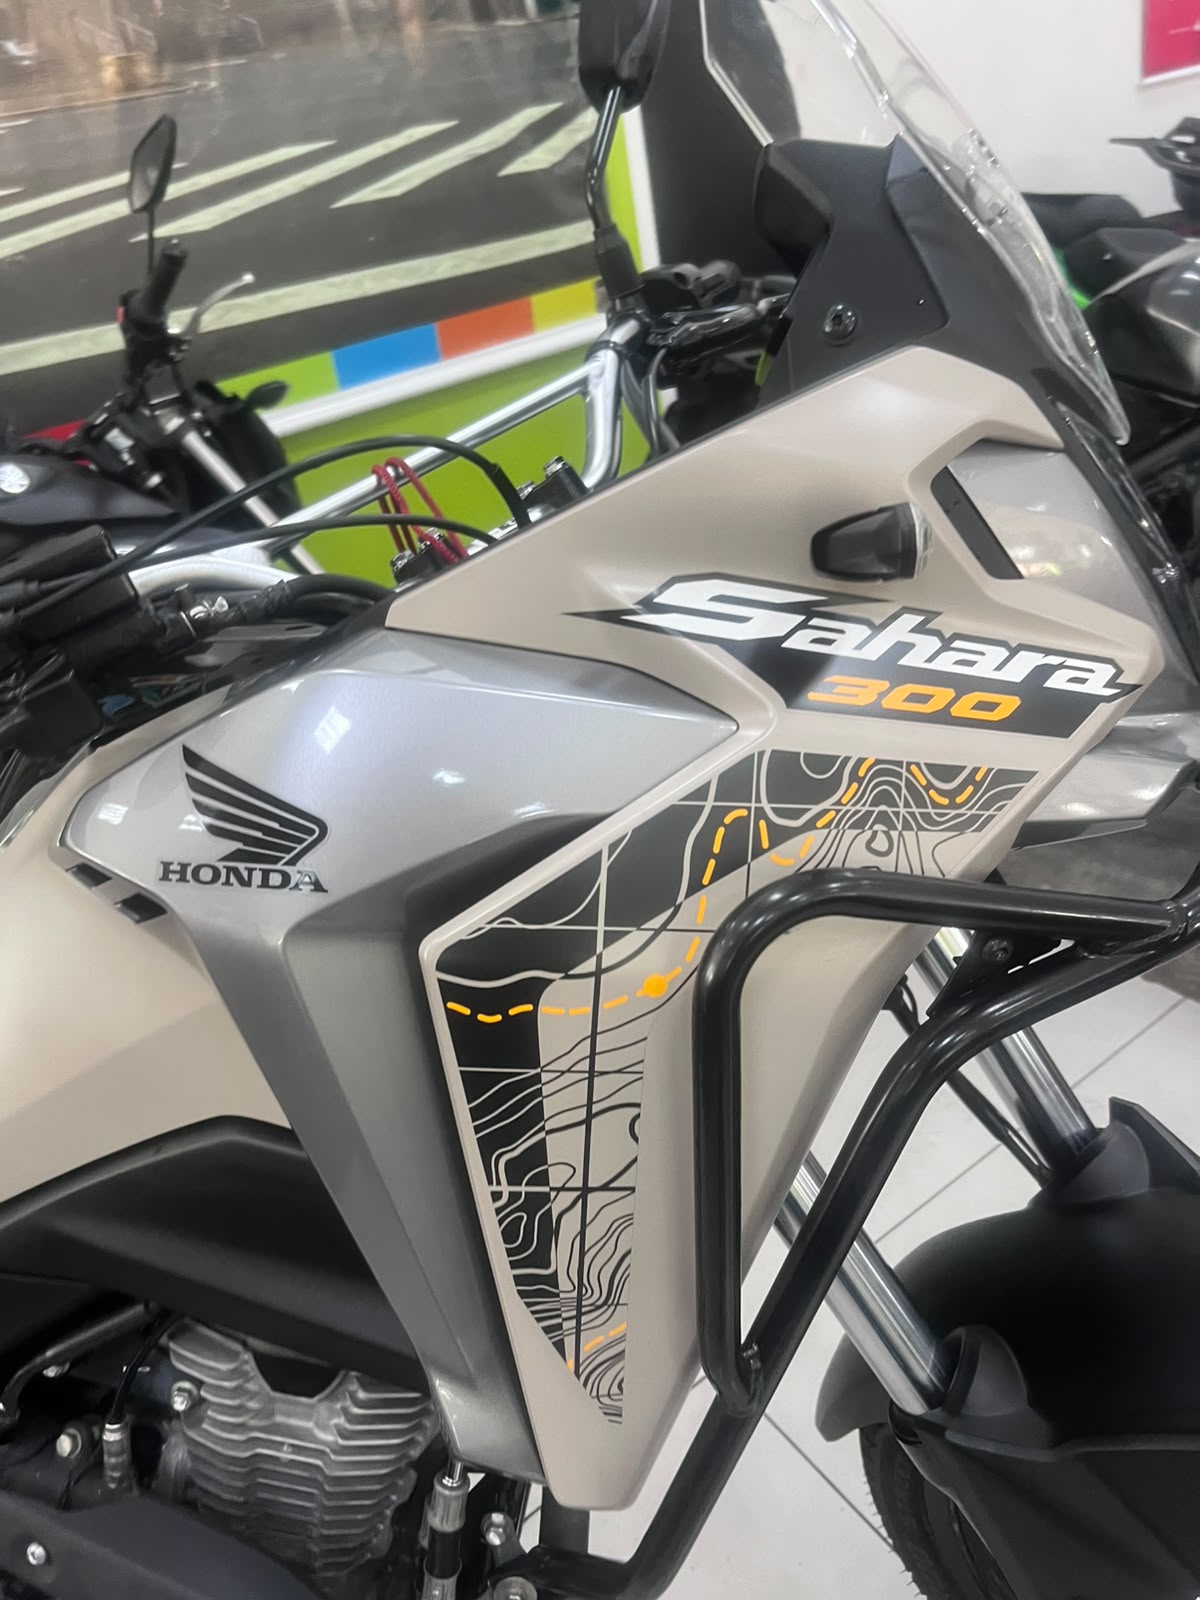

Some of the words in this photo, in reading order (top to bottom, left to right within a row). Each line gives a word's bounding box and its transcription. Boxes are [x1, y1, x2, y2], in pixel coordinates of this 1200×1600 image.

[620, 578, 1124, 697] Sahara
[807, 675, 1022, 722] 300
[158, 860, 329, 894] HONDA
